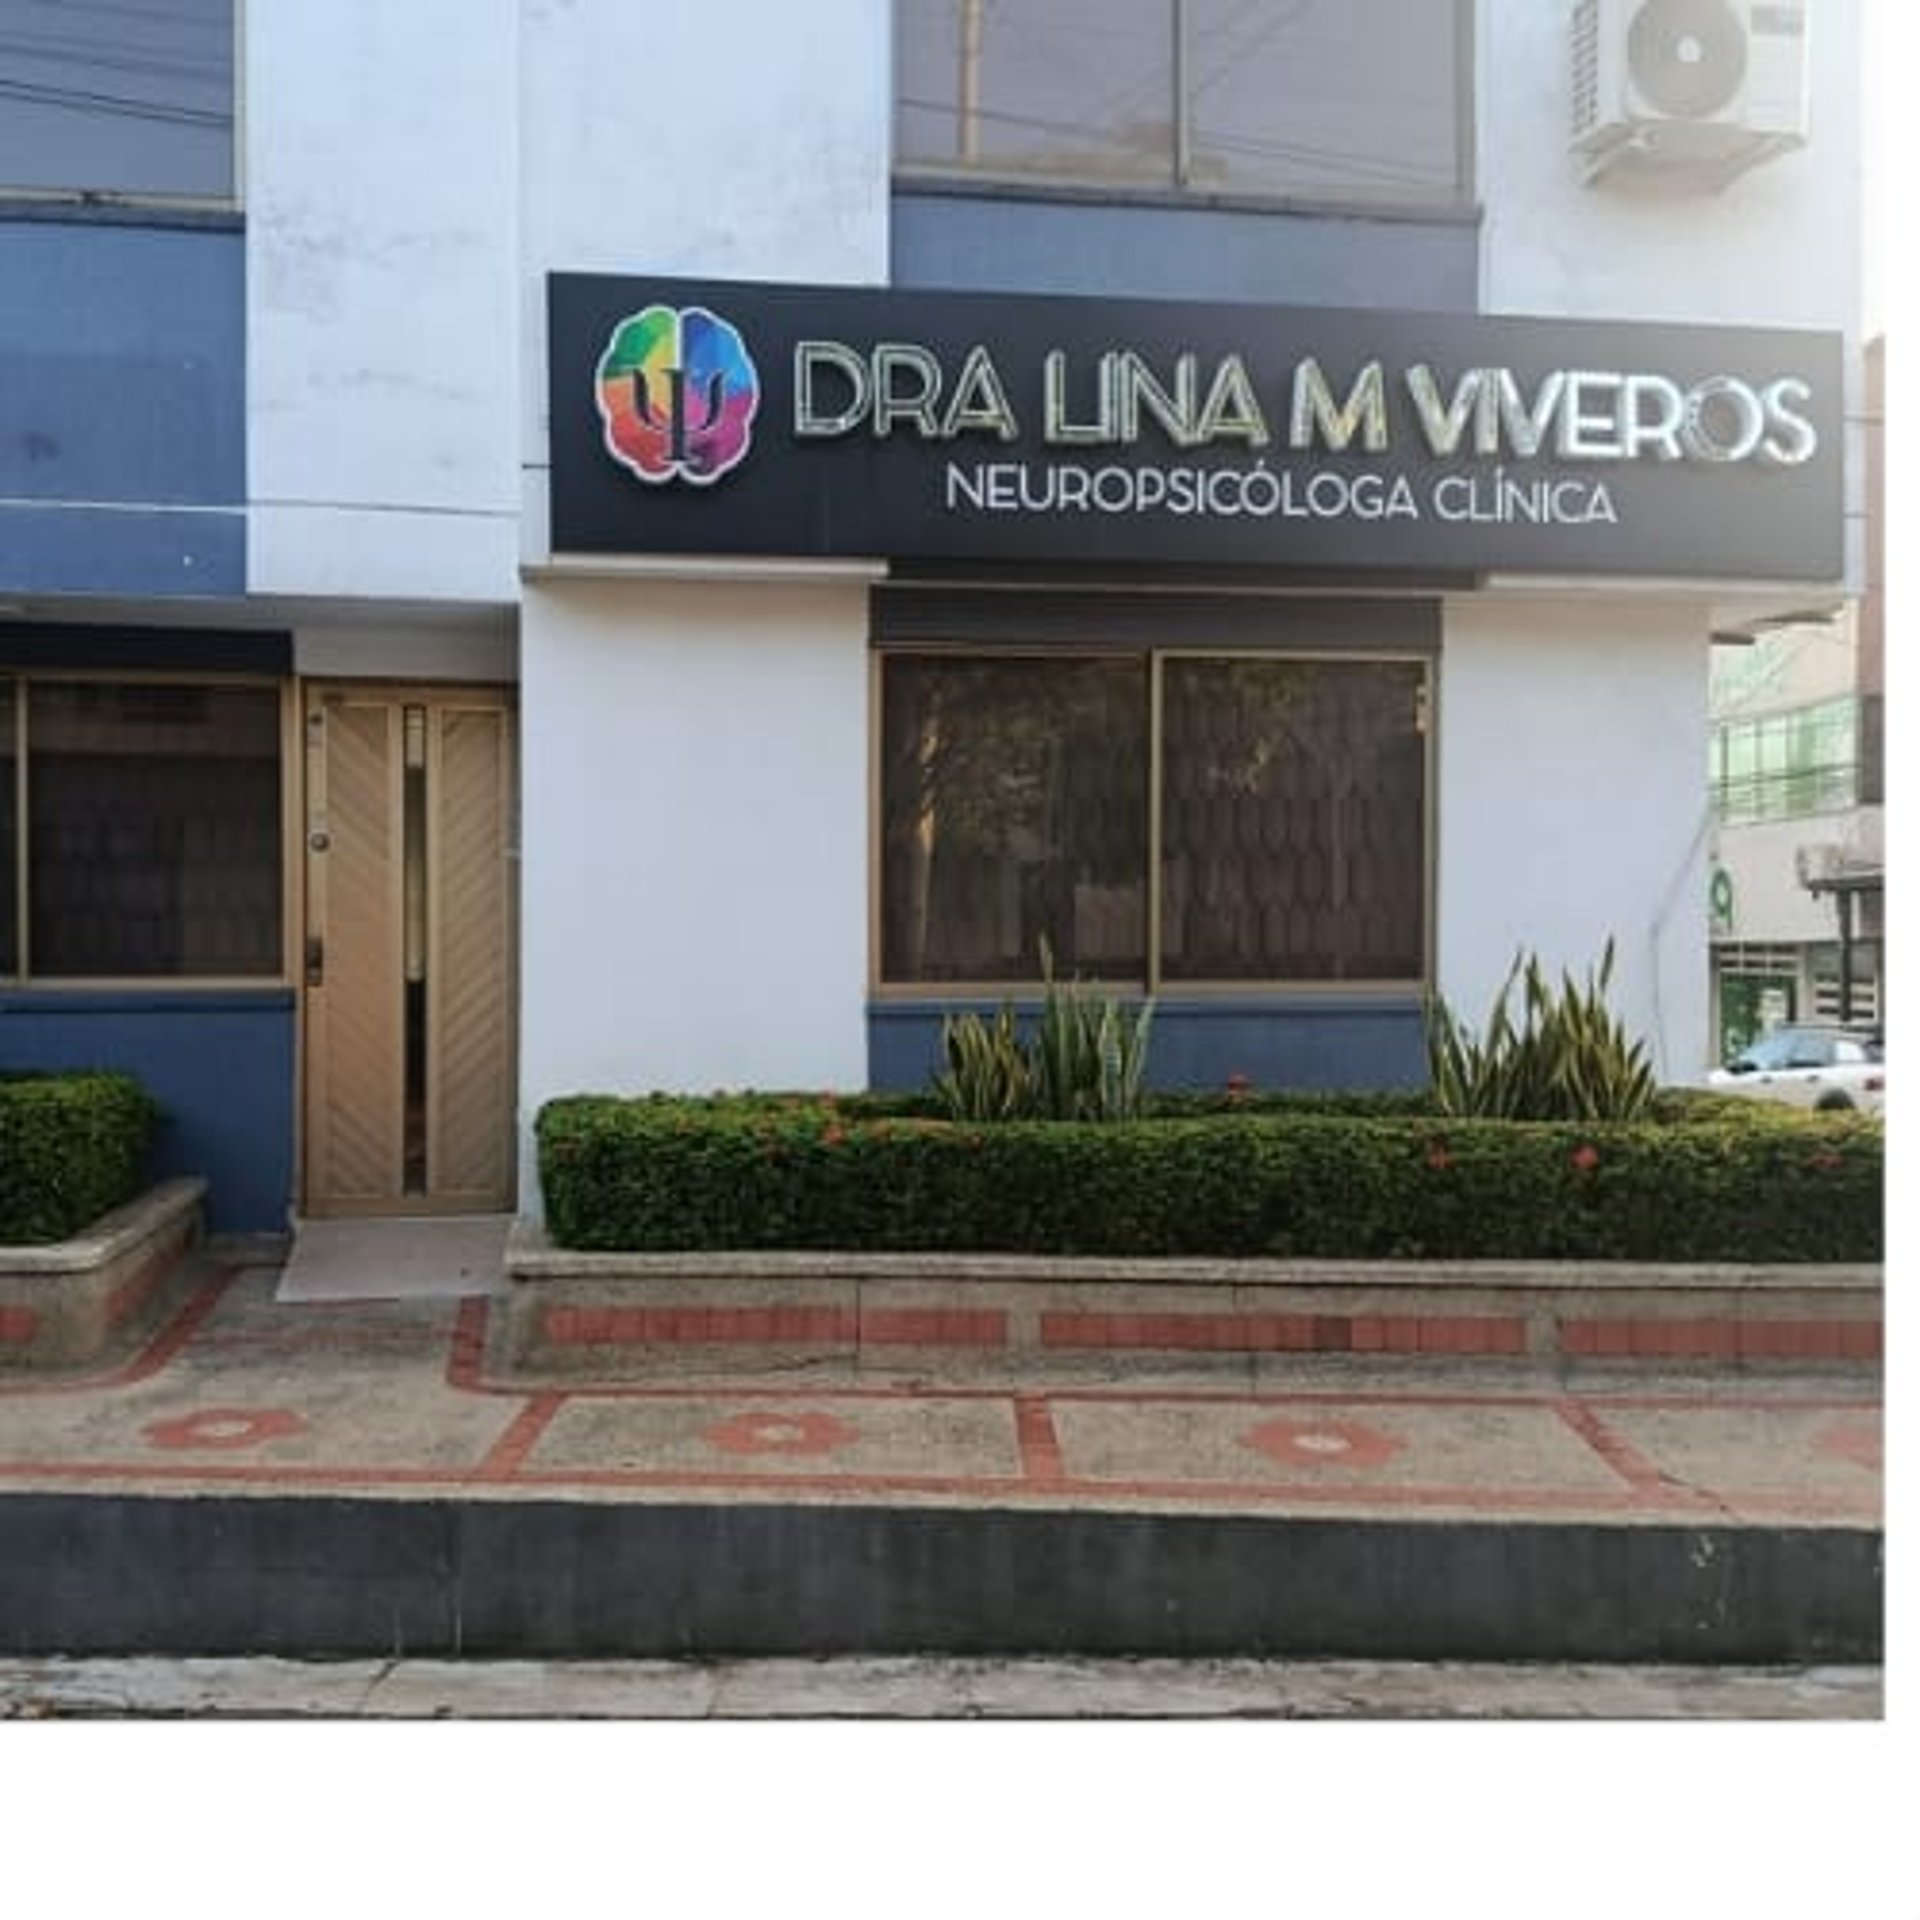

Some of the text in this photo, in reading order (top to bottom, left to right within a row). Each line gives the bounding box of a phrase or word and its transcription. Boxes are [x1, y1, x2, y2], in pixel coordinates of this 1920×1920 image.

[794, 340, 1818, 465] DRA LINA M VIVEROS
[946, 460, 1617, 524] NEUROPSICÓLOGA CLÍNICA
